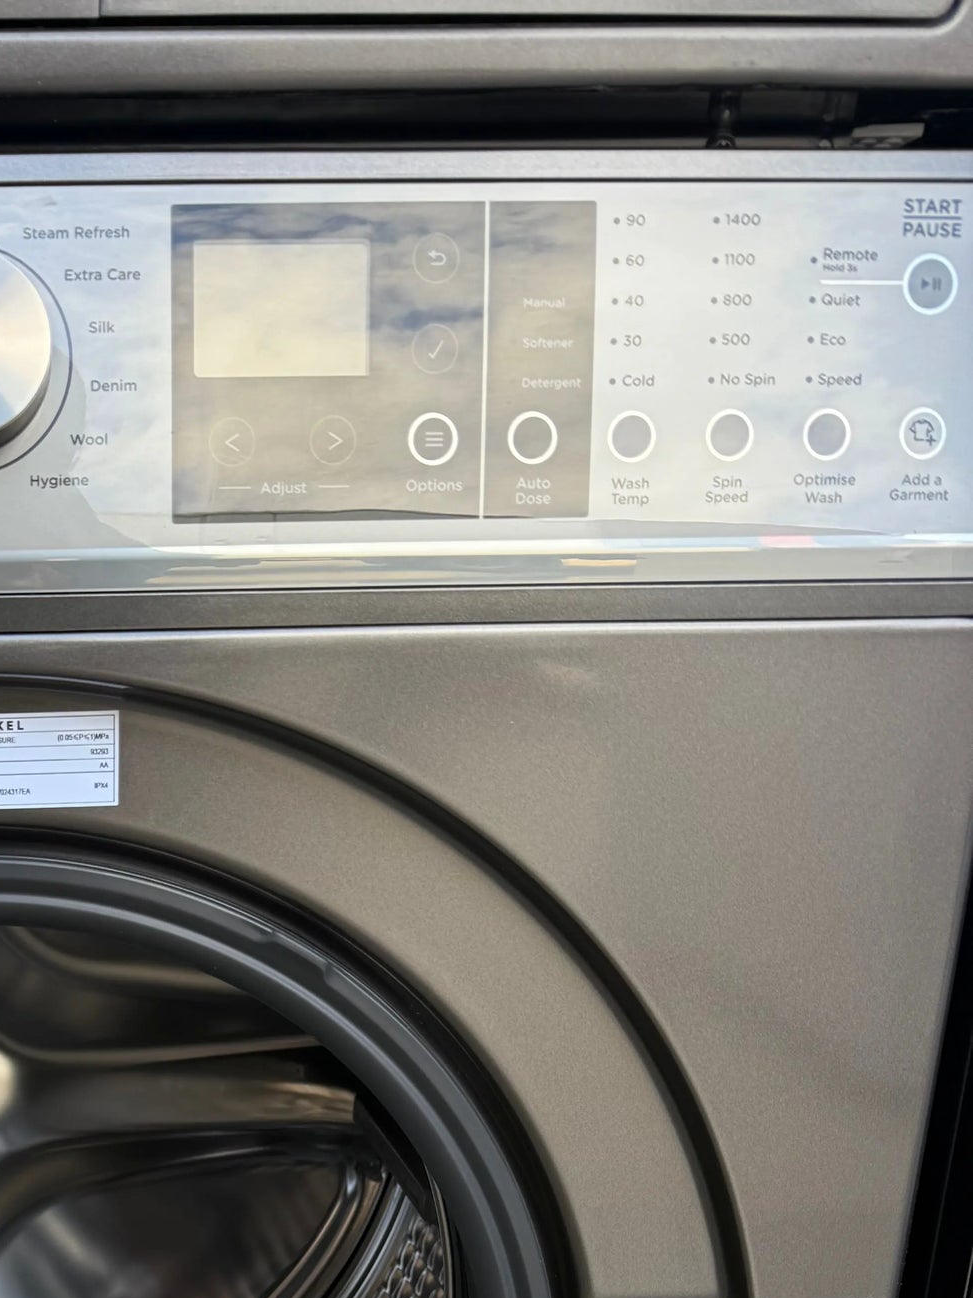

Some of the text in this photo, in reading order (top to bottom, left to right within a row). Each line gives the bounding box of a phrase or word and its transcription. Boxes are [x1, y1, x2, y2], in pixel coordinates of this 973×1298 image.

[904, 199, 962, 213] START
[626, 215, 645, 226] 90
[725, 214, 761, 226] 1400
[23, 226, 129, 239] Steam Refresh
[903, 222, 961, 238] PAUSE
[625, 255, 645, 266] 60
[725, 254, 755, 265] 1100
[823, 248, 878, 261] Remote
[823, 263, 857, 272] Hold 3s
[64, 268, 141, 281] Extra Care
[523, 297, 565, 308] Manual
[625, 295, 644, 307] 40
[723, 294, 752, 306] 800
[822, 294, 860, 307] Quiet
[88, 321, 115, 334] Silk
[523, 337, 573, 348] Softener
[623, 335, 641, 346] 30
[722, 334, 750, 345] 500
[820, 334, 846, 346] Eco
[90, 379, 137, 392] Denim
[522, 377, 581, 389] Detergent
[622, 375, 655, 387] Cold
[720, 373, 775, 387] No Spin
[818, 373, 862, 387] Speed
[70, 433, 108, 446] Wool
[30, 474, 89, 489] Hygiene
[406, 479, 463, 493] Options
[516, 476, 551, 489] Auto
[611, 478, 649, 489] Wash
[712, 476, 742, 489] Spin
[794, 473, 855, 488] Optimise
[902, 474, 942, 486] Add a
[261, 480, 307, 495] Adjust
[516, 492, 551, 504] Dose
[611, 493, 649, 506] Temp
[705, 491, 748, 504] Speed
[805, 492, 842, 503] Wash
[890, 489, 948, 501] Garment
